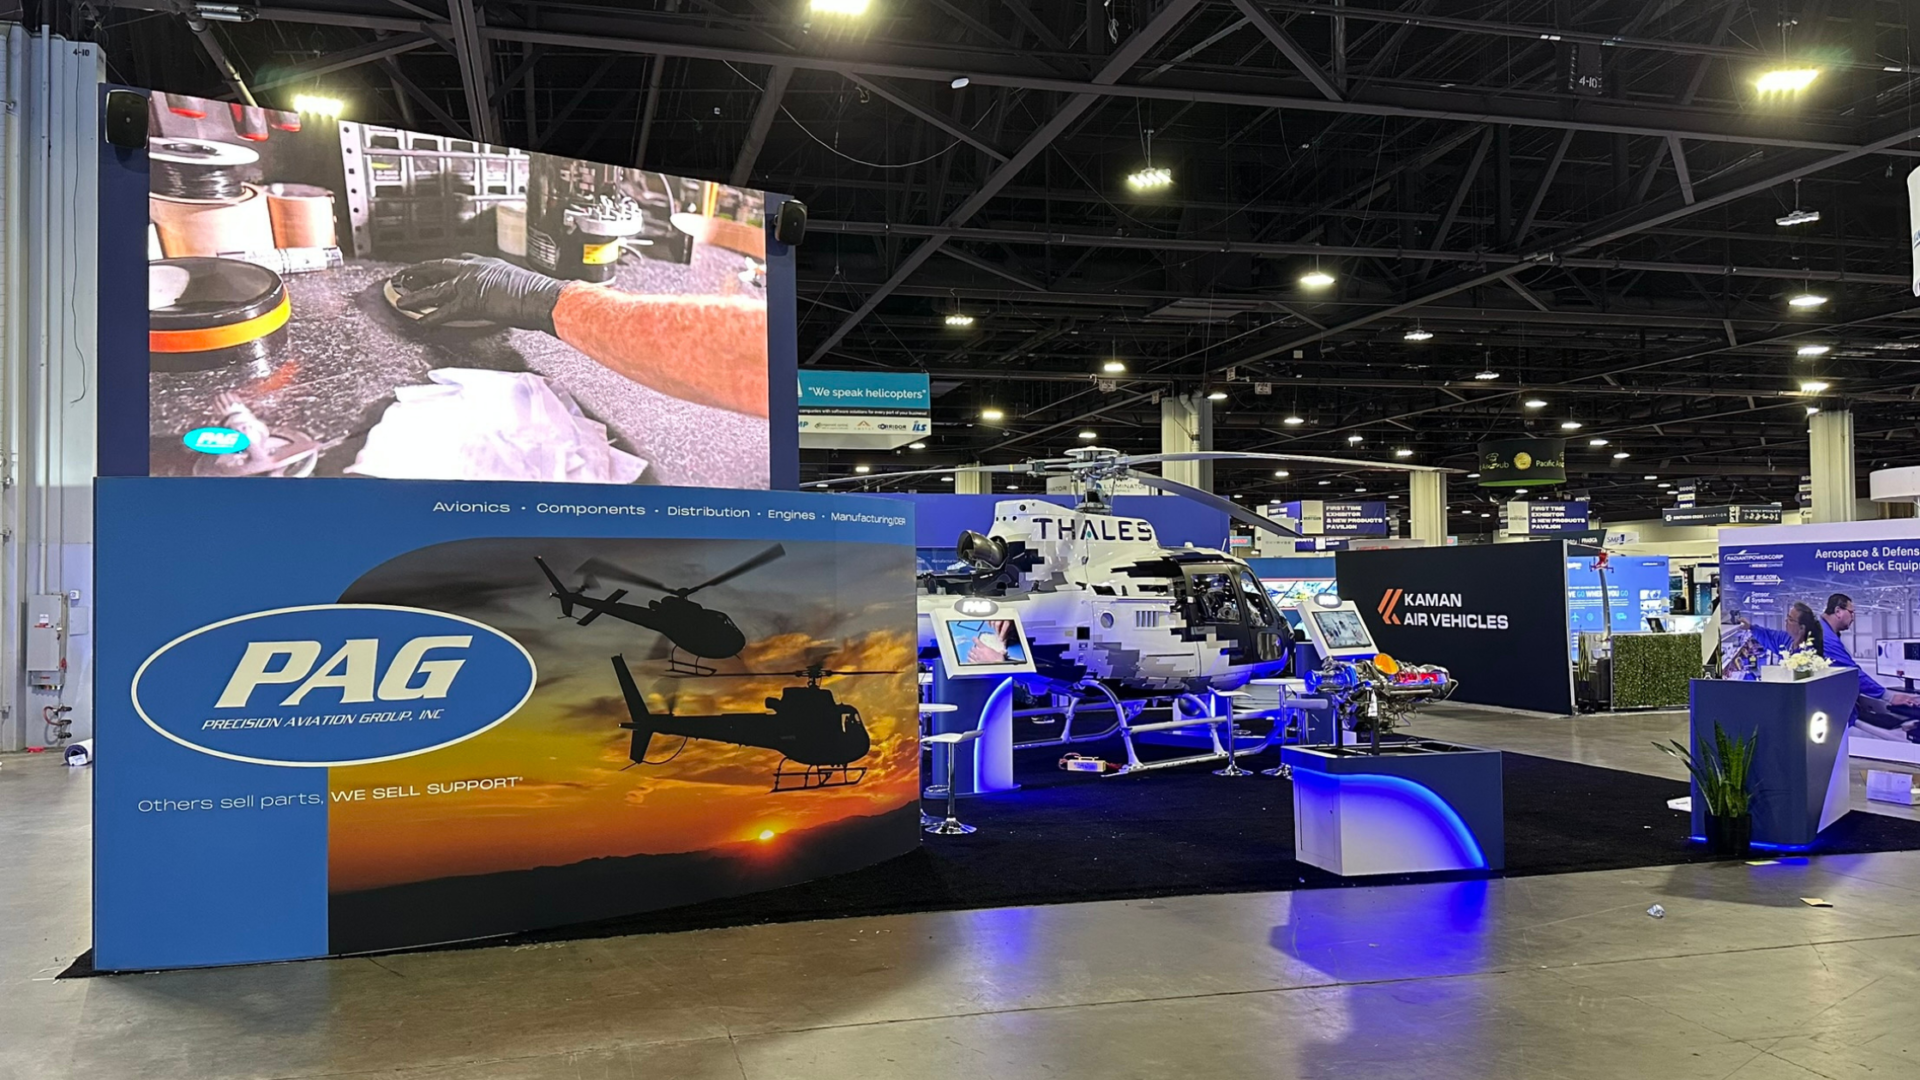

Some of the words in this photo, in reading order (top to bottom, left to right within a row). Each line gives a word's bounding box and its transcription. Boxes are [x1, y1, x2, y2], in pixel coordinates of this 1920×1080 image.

[73, 49, 90, 57] 4-10
[1579, 75, 1598, 89] 4-10
[832, 388, 863, 399] speak
[195, 432, 240, 444] PAG
[433, 502, 511, 514] Avionics
[536, 502, 646, 517] Components
[667, 505, 750, 518] Distribution
[767, 509, 816, 522] Engines
[1033, 518, 1152, 541] THALES
[1815, 549, 1868, 559] Aerospace
[1872, 547, 1879, 557] &
[1827, 562, 1855, 573] Flight
[1859, 561, 1884, 571] Deck
[1404, 593, 1462, 607] KAMAN
[1404, 613, 1428, 626] AIR
[1430, 614, 1509, 629] VEHICLES
[214, 635, 473, 708] PAG
[202, 717, 282, 730] PRECISION
[284, 714, 357, 727] AVIATION
[419, 709, 444, 719] INC
[137, 798, 213, 812] Others
[220, 796, 254, 809] sell
[260, 792, 325, 810] parts,
[331, 790, 366, 803] WE
[372, 786, 420, 799] SELL
